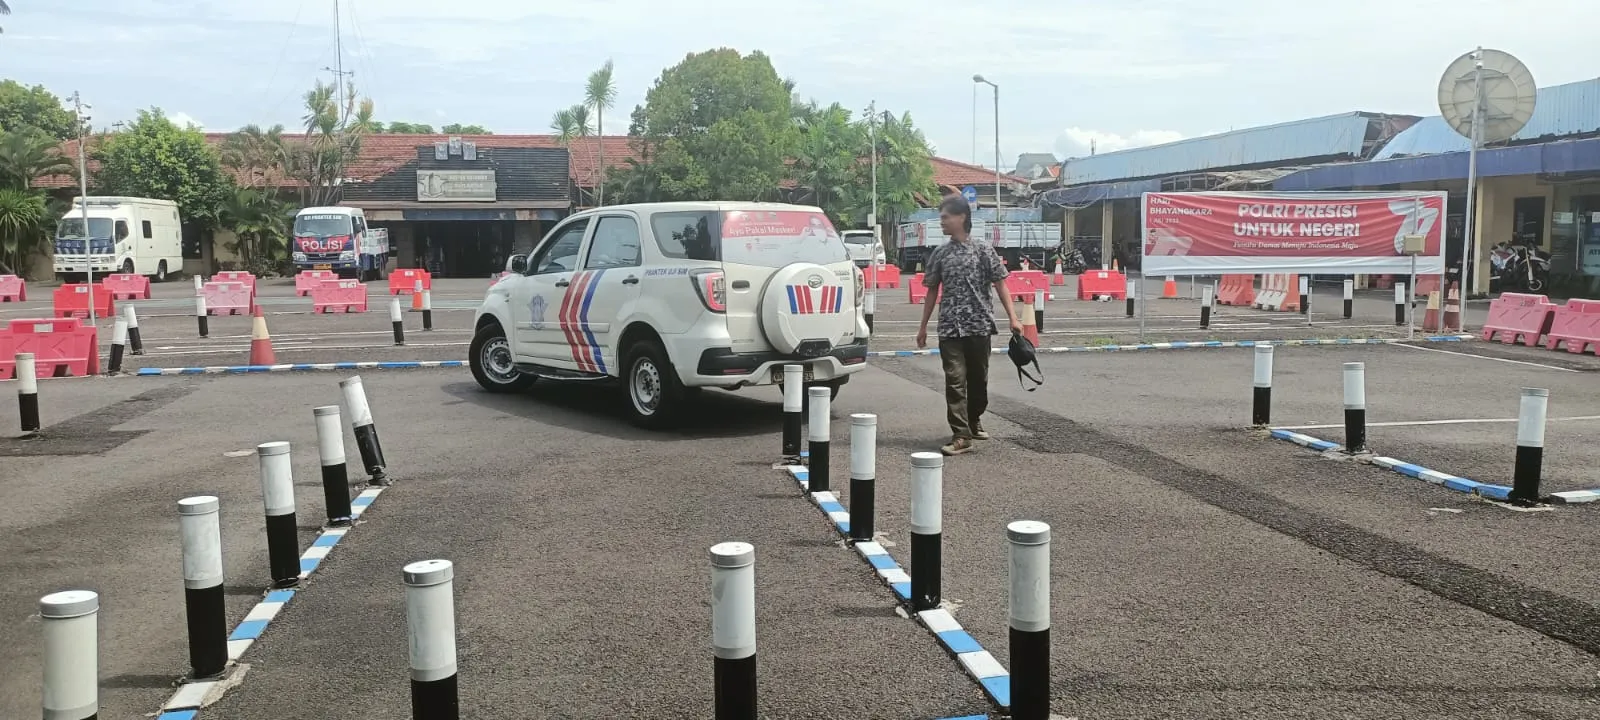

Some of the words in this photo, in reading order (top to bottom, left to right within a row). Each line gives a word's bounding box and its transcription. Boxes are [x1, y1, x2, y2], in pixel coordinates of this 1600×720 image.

[1151, 207, 1212, 215] BHAYANGKARA
[1238, 204, 1288, 218] POLRI
[1294, 204, 1357, 218] PRESISI
[1233, 222, 1295, 236] UNTUK
[1300, 223, 1360, 236] NEGERI
[302, 240, 343, 250] POLISI
